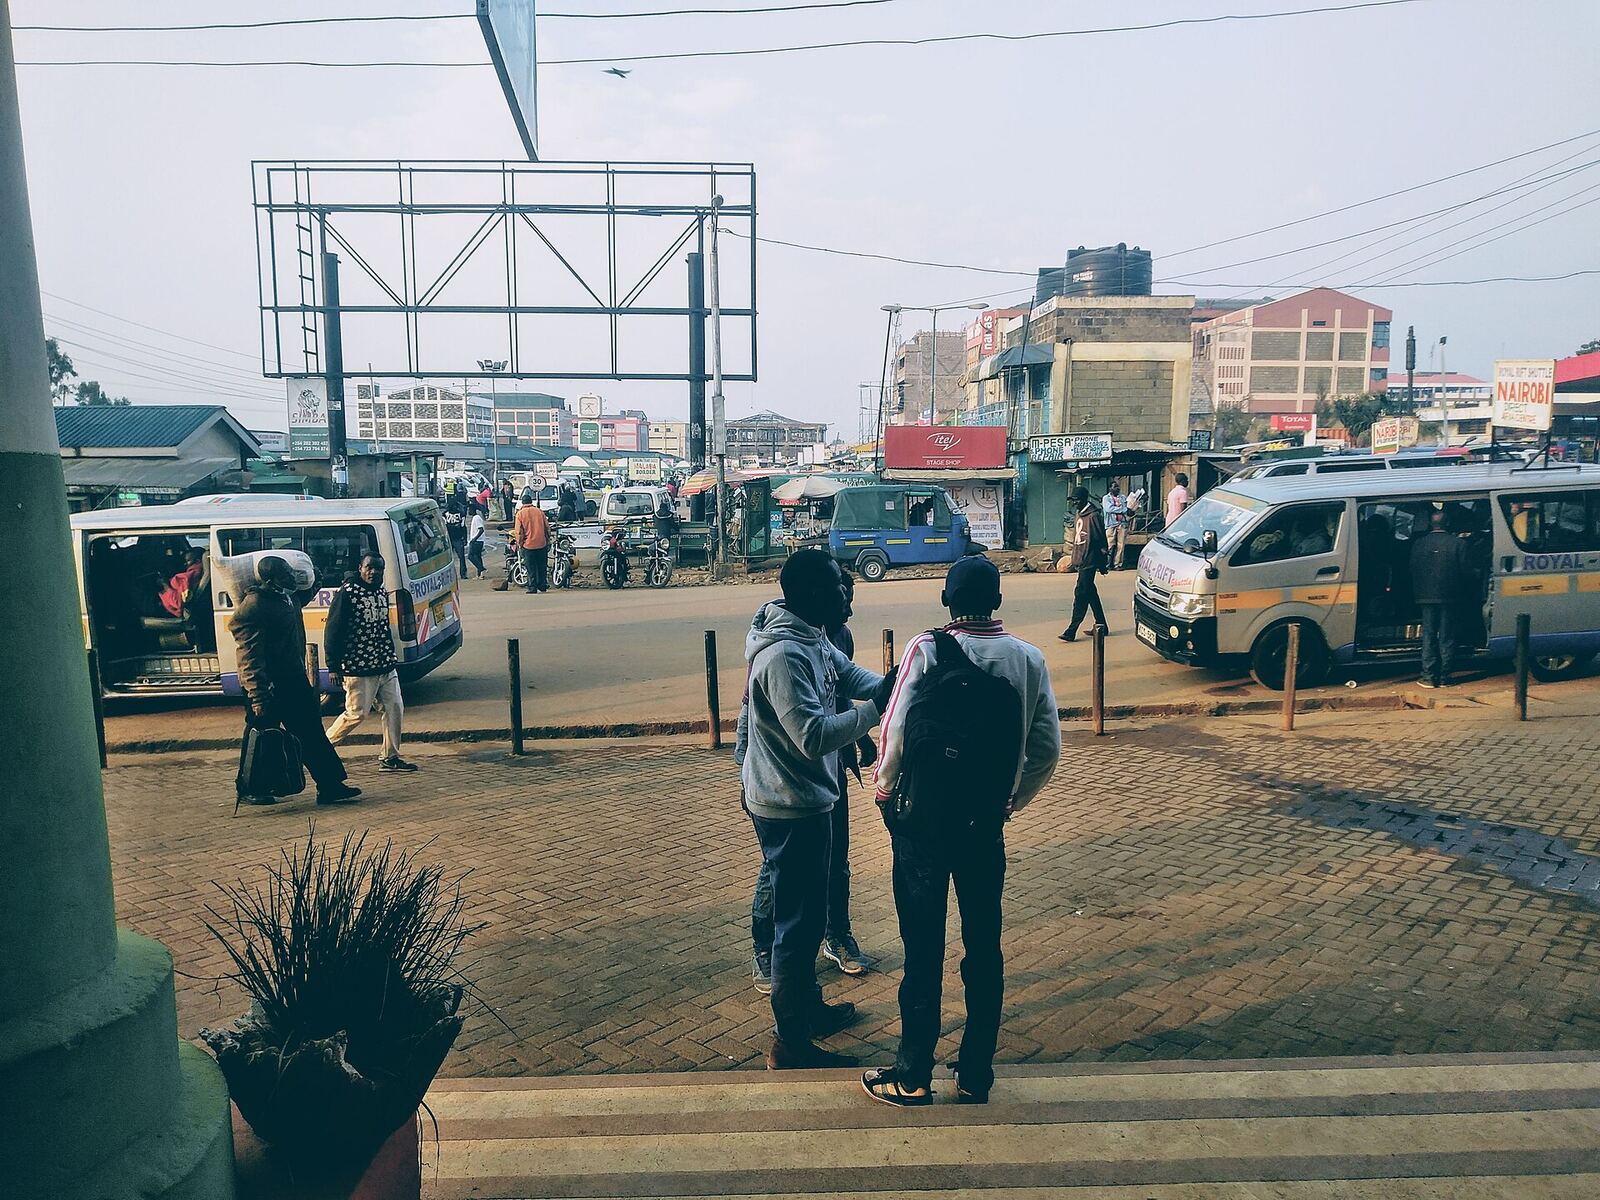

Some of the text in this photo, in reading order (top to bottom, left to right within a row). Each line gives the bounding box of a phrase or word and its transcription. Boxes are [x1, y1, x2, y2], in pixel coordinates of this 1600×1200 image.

[1497, 381, 1551, 405] NAIROBI
[1031, 438, 1072, 448] M-PESA
[1031, 453, 1064, 461] REPAIR
[1523, 553, 1585, 570] ROYAL
